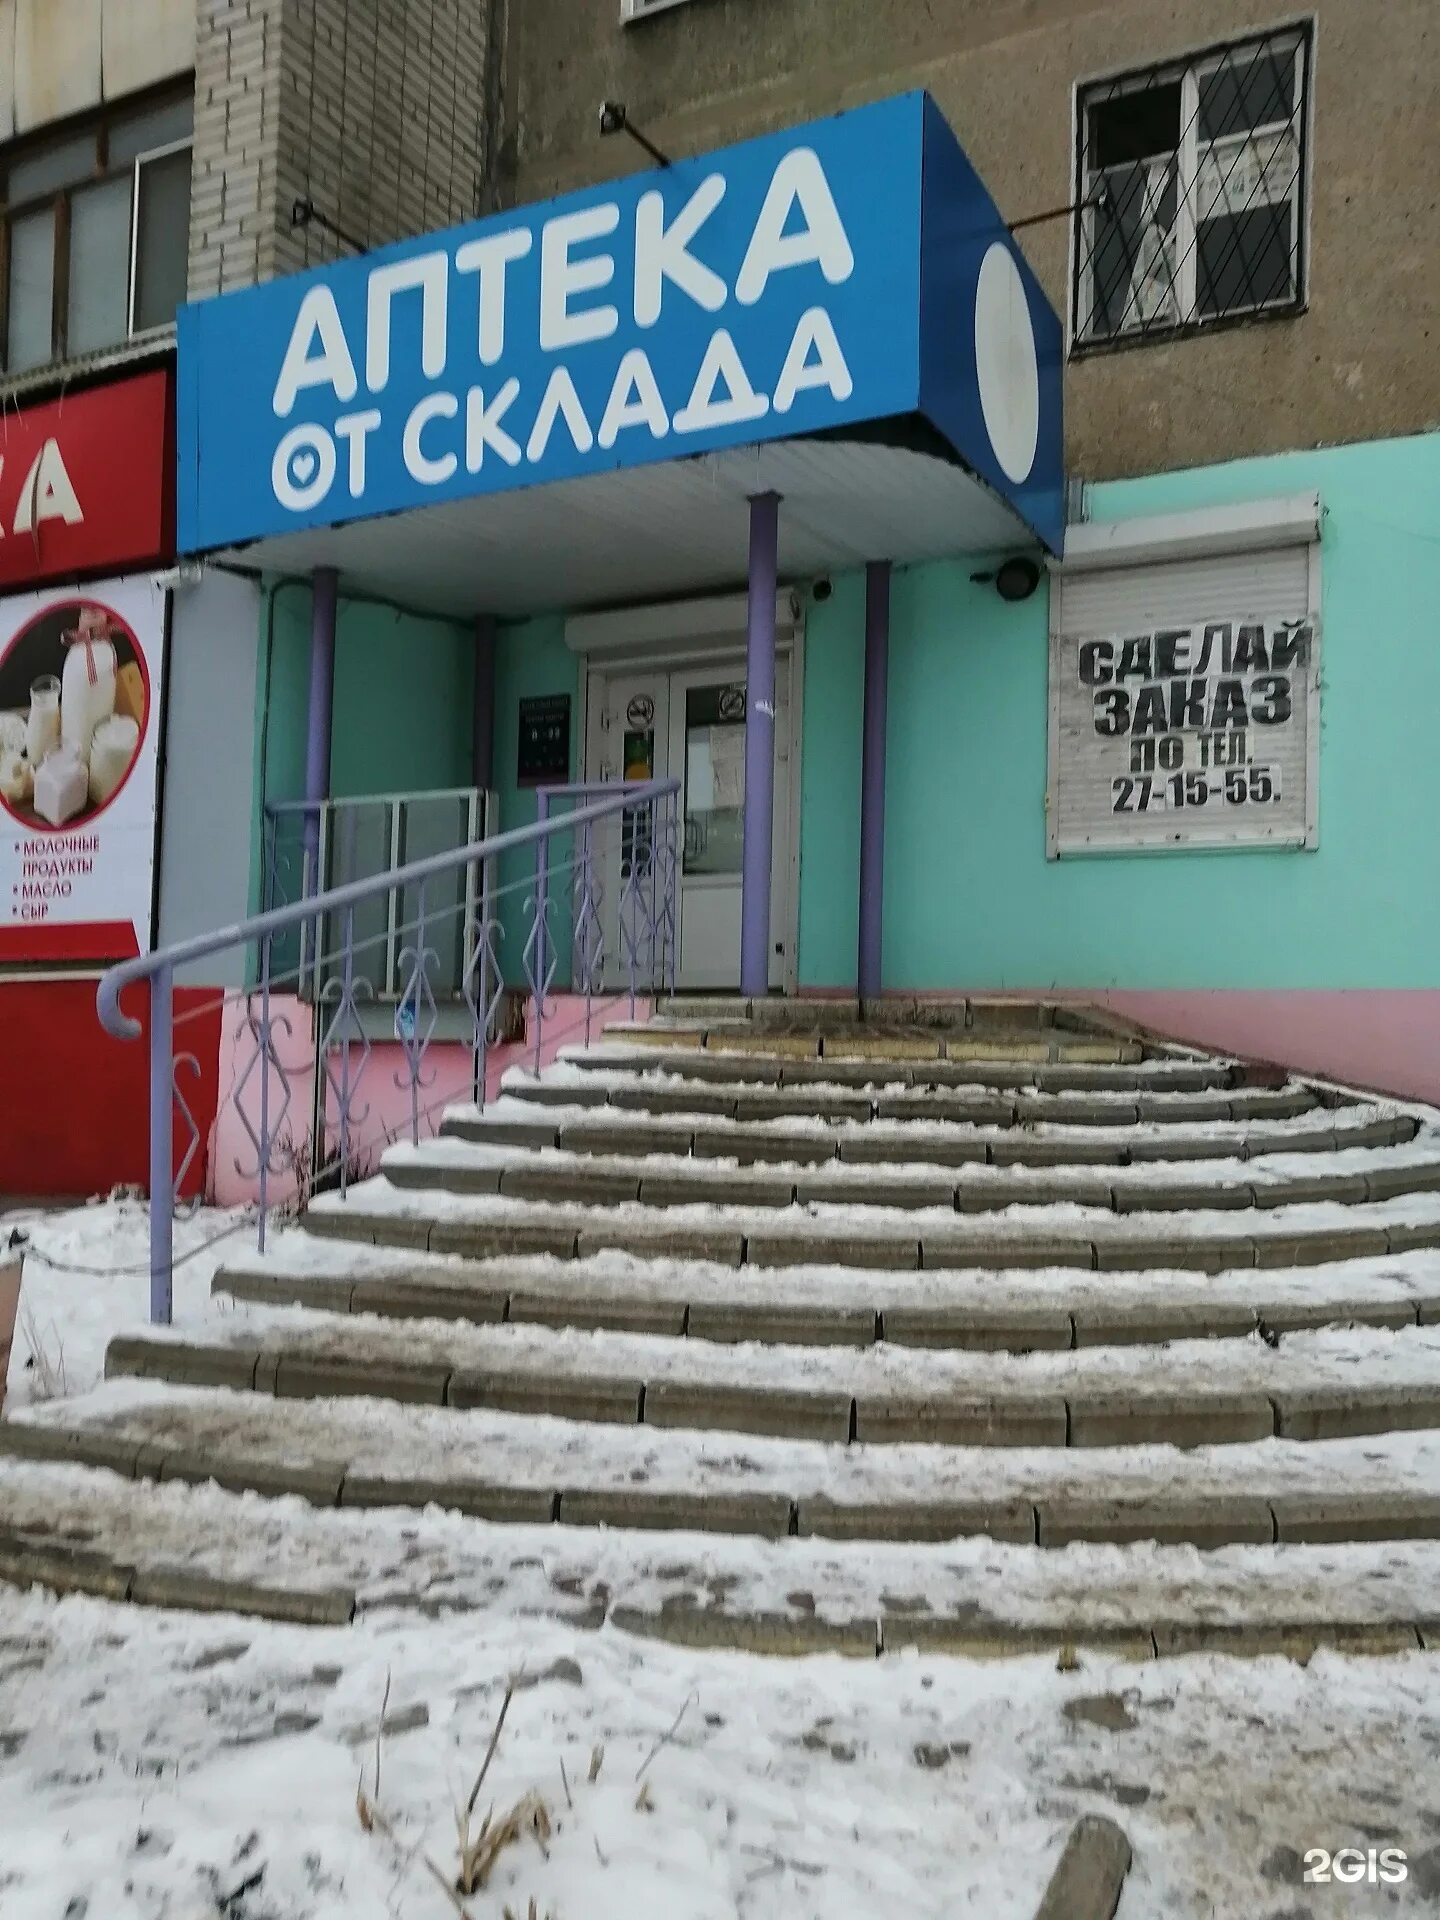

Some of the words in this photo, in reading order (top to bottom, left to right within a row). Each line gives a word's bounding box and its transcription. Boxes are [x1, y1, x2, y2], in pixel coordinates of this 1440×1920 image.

[272, 146, 854, 418] АПТЕКА
[271, 409, 381, 512] ОТ
[402, 306, 853, 485] СКЛАДА
[0, 437, 84, 540] А
[1079, 618, 1313, 685] СДЕЛАЙ
[1094, 676, 1292, 736] ЗАКАЗ
[1130, 736, 1184, 773] ПО
[1112, 765, 1281, 812] 27-15-55.
[23, 857, 93, 878] ПРОДУКТЫ
[24, 835, 99, 858] МОЛОЧНЫЕ
[21, 902, 49, 921] СЫР
[22, 880, 72, 900] МАСЛО
